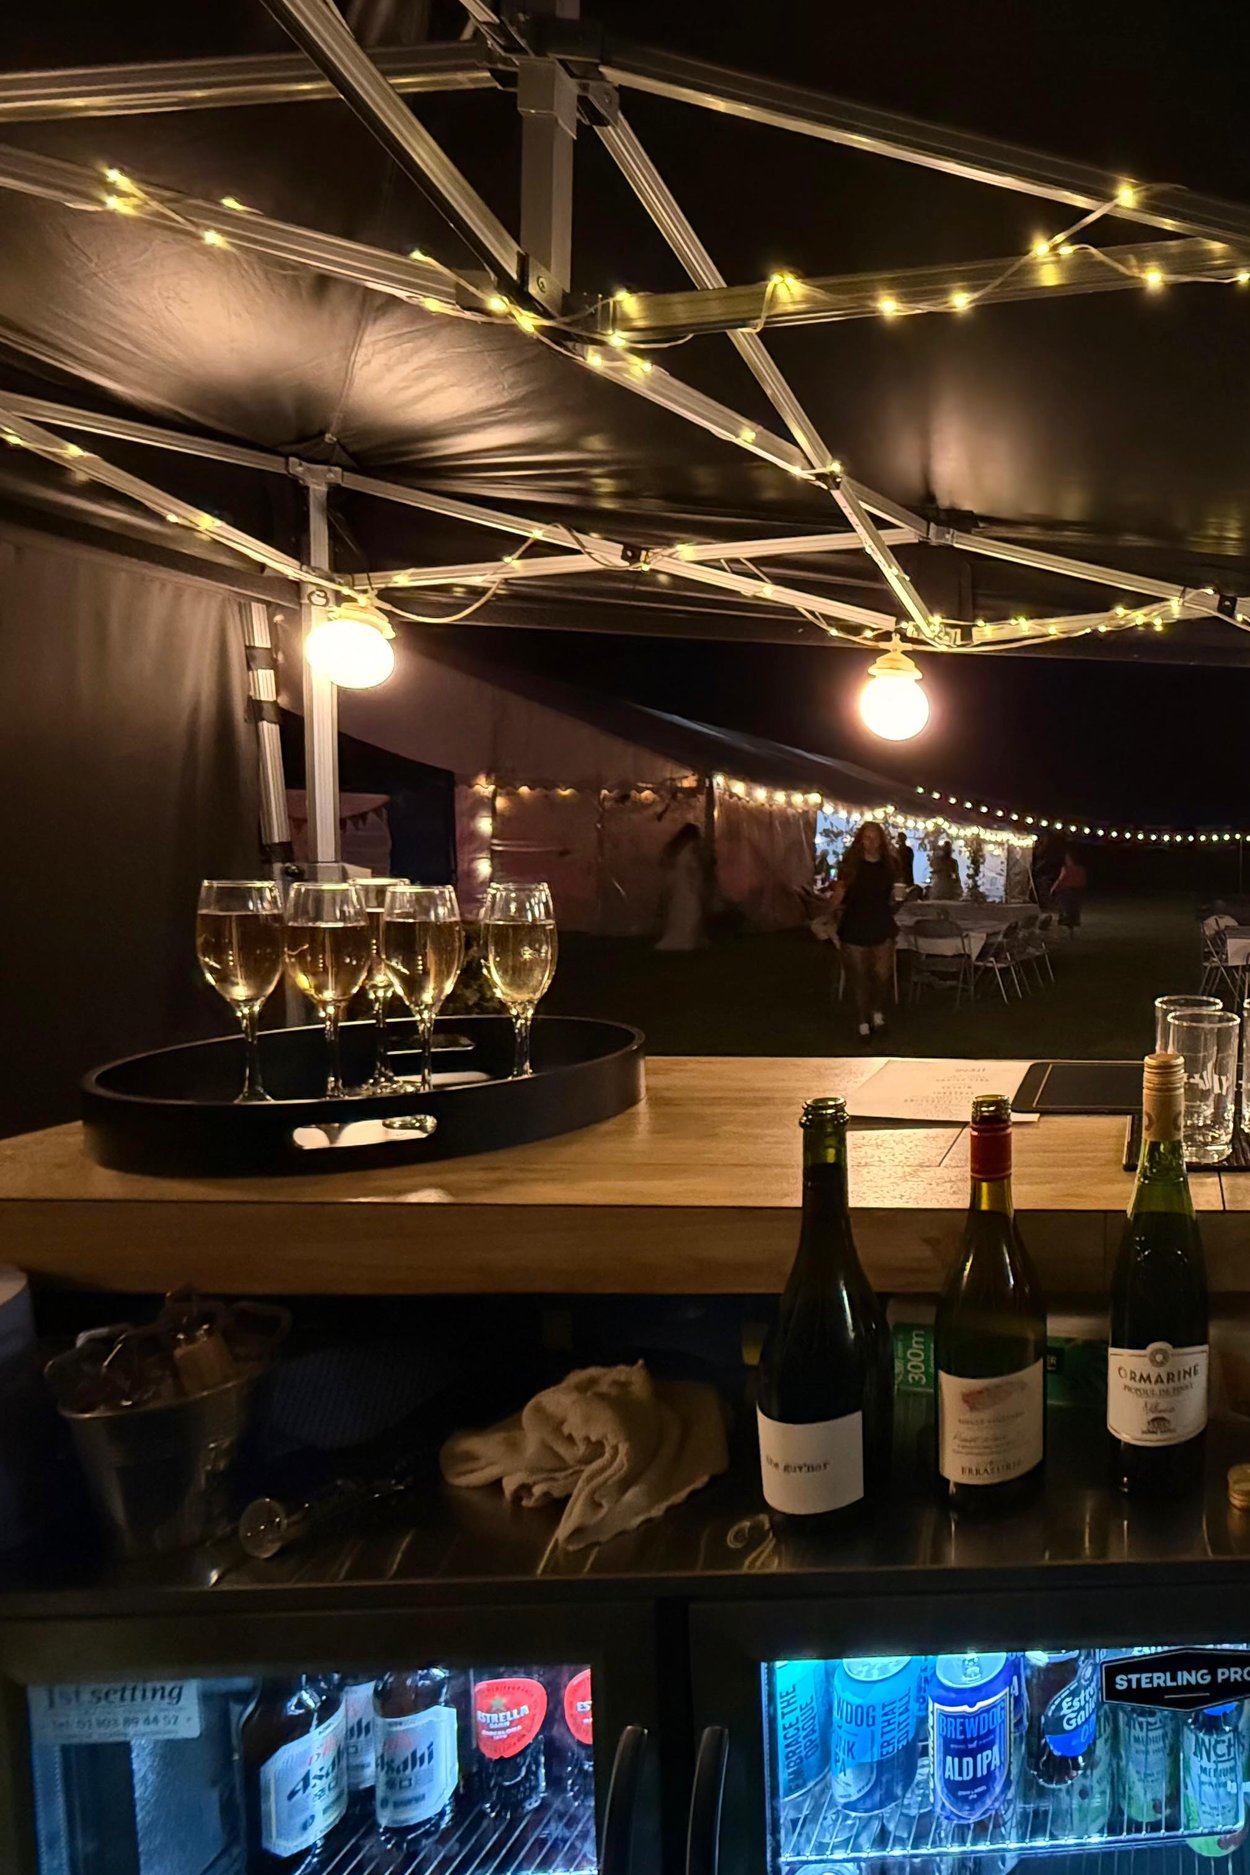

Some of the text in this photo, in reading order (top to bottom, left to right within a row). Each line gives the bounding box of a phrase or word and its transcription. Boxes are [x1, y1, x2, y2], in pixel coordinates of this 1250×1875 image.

[1118, 1364, 1200, 1384] ORMARINE
[90, 1681, 184, 1705] setting
[1115, 1669, 1211, 1690] STERLING
[780, 1684, 797, 1720] THE
[881, 1700, 898, 1738] THAT
[798, 1695, 818, 1760] OPAQUE
[938, 1702, 1006, 1740] BREWDOG
[944, 1744, 1000, 1782] ALD IPA
